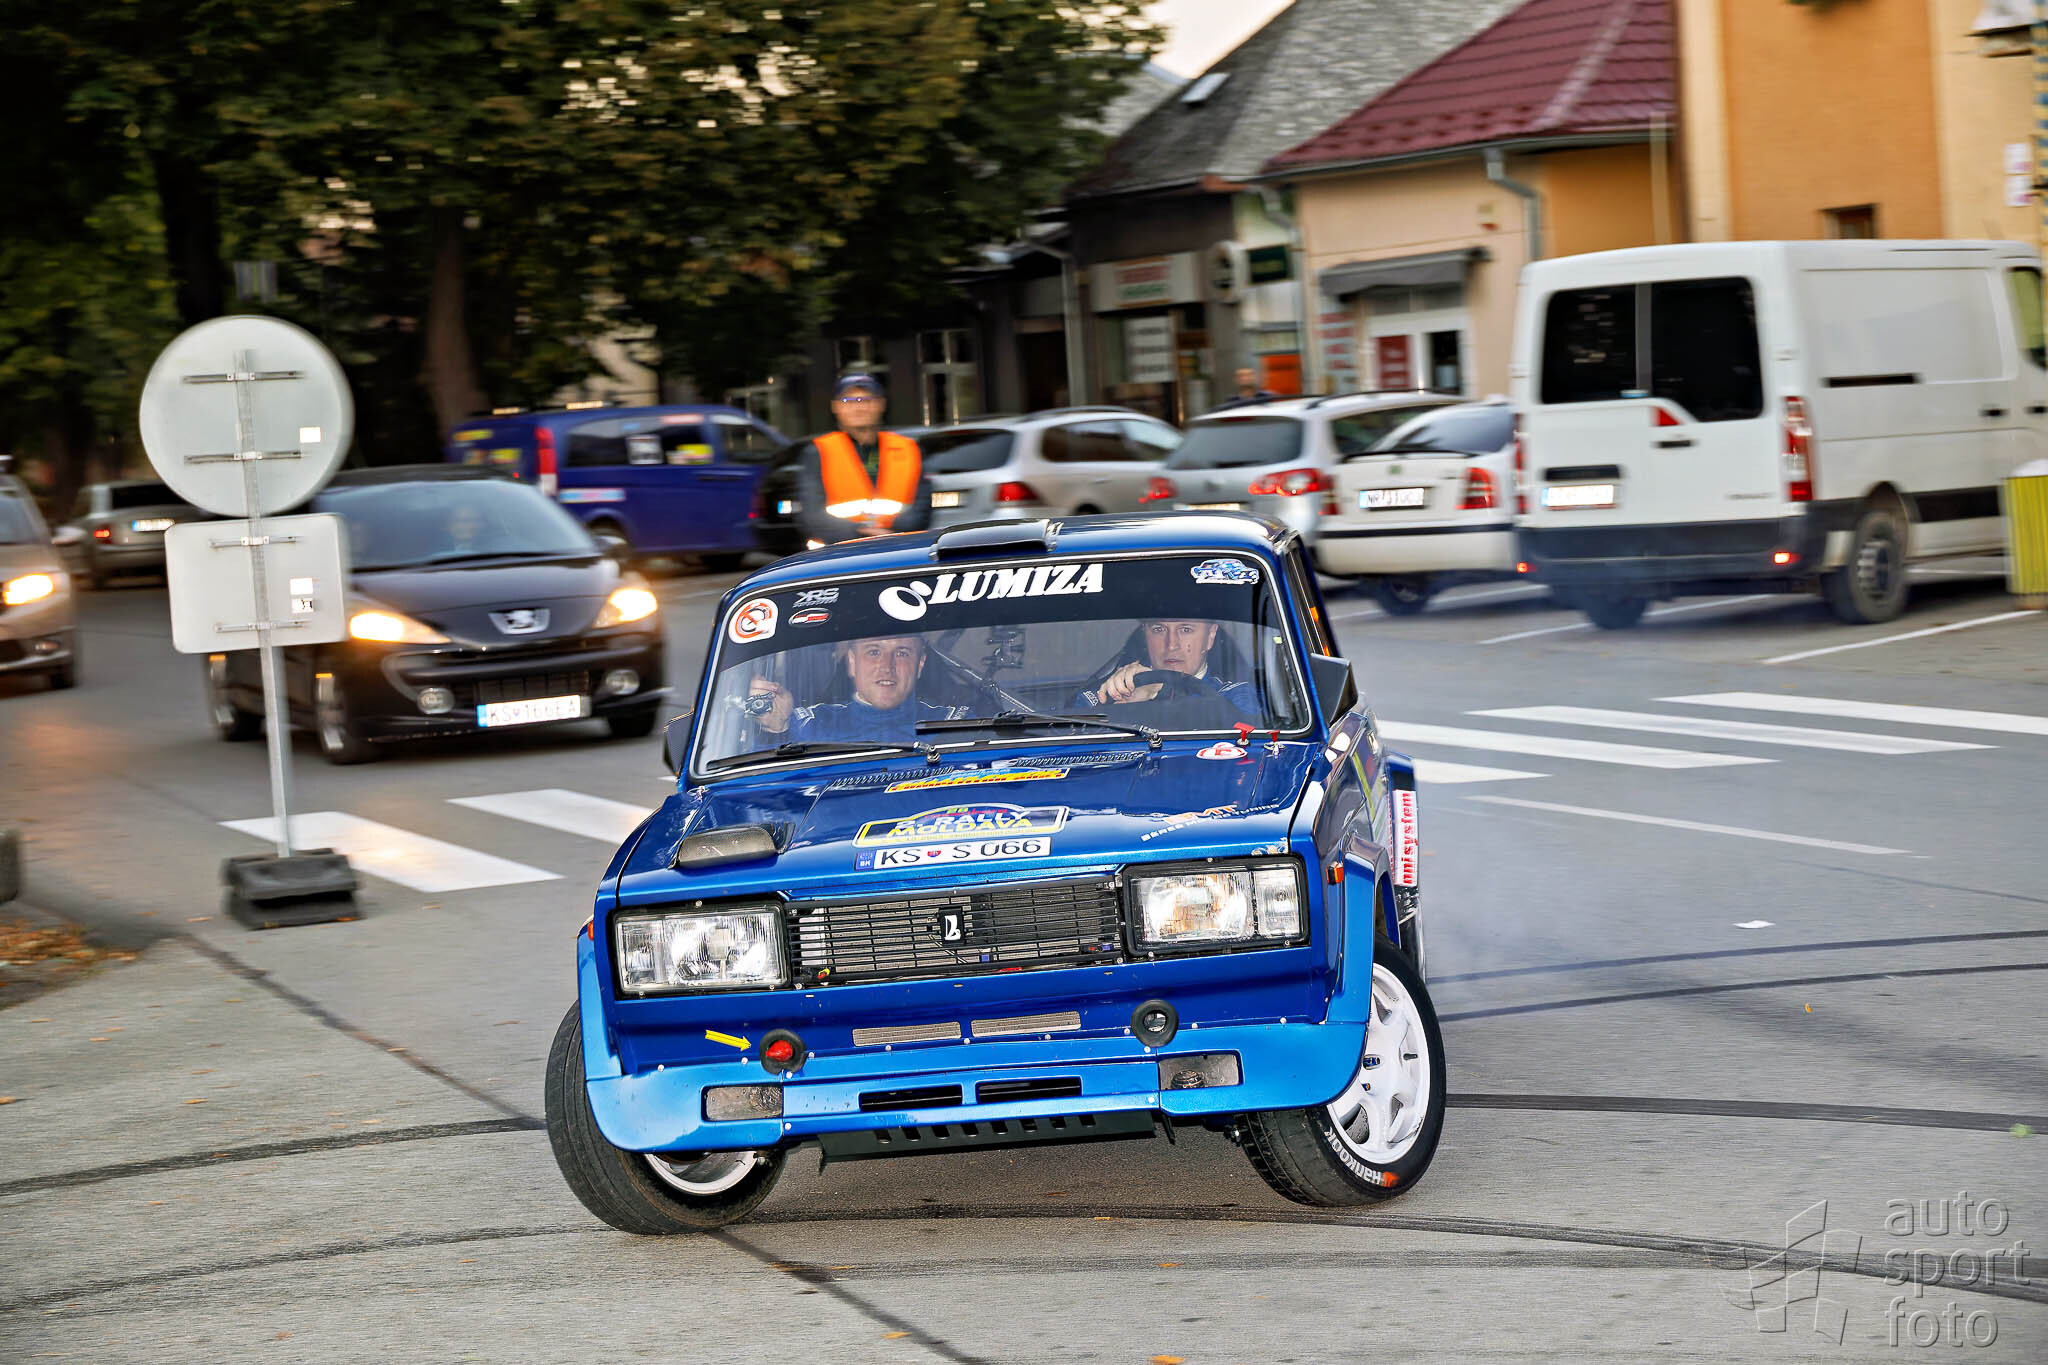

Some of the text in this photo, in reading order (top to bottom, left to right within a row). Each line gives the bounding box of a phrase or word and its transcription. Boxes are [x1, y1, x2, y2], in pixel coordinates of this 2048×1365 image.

[887, 818, 1034, 838] MOLDAVA
[934, 810, 1031, 826] RALLY
[881, 839, 1042, 866] KS S 066
